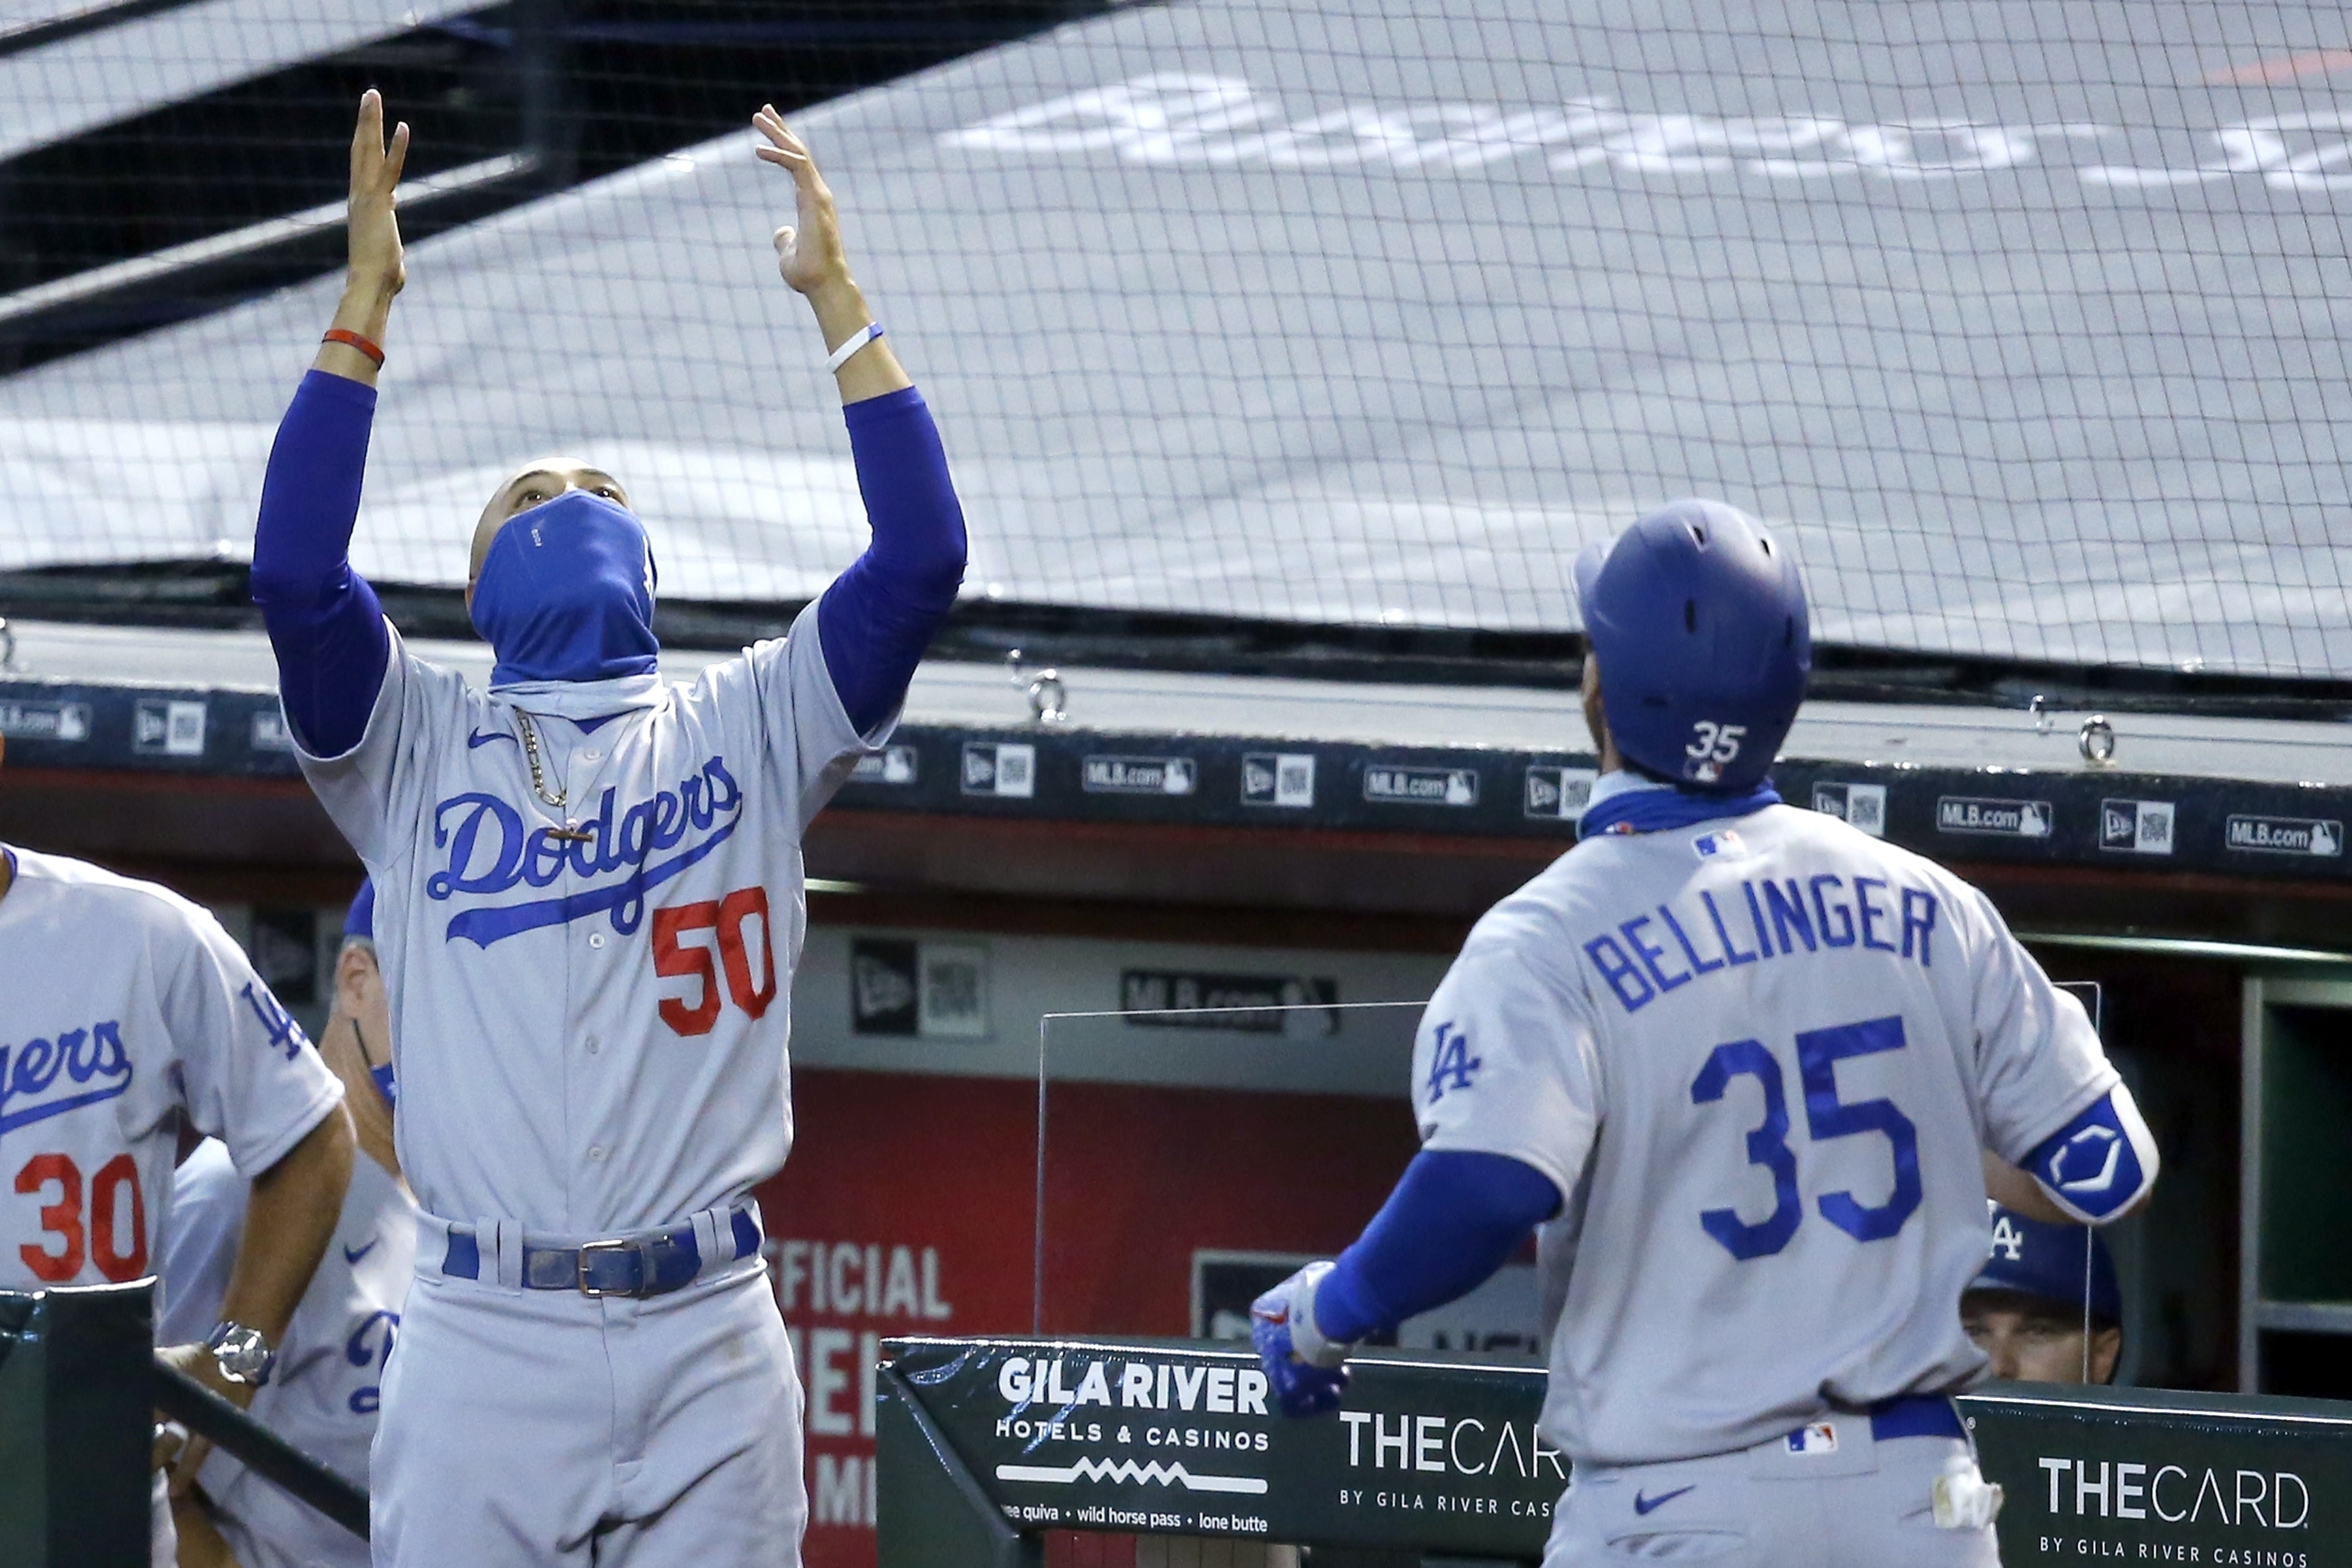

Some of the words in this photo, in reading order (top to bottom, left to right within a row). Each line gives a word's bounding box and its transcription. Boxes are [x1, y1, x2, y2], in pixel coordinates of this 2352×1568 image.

[1686, 720, 1748, 763] 35
[1368, 771, 1446, 797] MLB.com
[1942, 802, 2018, 828] MLB.com
[2231, 820, 2308, 848] MLB.com
[427, 756, 742, 936] Dodgers
[652, 886, 777, 1037] 50
[1584, 874, 1936, 1013] BELLINGER
[1426, 1022, 1482, 1102] LA
[1692, 1015, 1924, 1262] 35
[14, 1153, 148, 1282] 30
[998, 1357, 1111, 1407] GILA
[1122, 1361, 1269, 1415] RIVER
[996, 1419, 1102, 1443] HOTELS
[1117, 1426, 1131, 1444] &
[1146, 1426, 1269, 1451] CASINOS
[1023, 1503, 1058, 1522] quiva
[1077, 1507, 1105, 1523] wild
[1109, 1508, 1146, 1525] horse
[1150, 1512, 1181, 1528] pass
[1199, 1512, 1228, 1529] lone
[1232, 1514, 1267, 1532] butte
[1340, 1490, 1363, 1504] BY
[1377, 1492, 1424, 1509] GILA
[1438, 1496, 1497, 1514] RIVER
[2040, 1537, 2063, 1552] BY
[2077, 1539, 2125, 1557] GILA
[2138, 1543, 2199, 1562] RIVER
[2213, 1548, 2308, 1568] CASINOS
